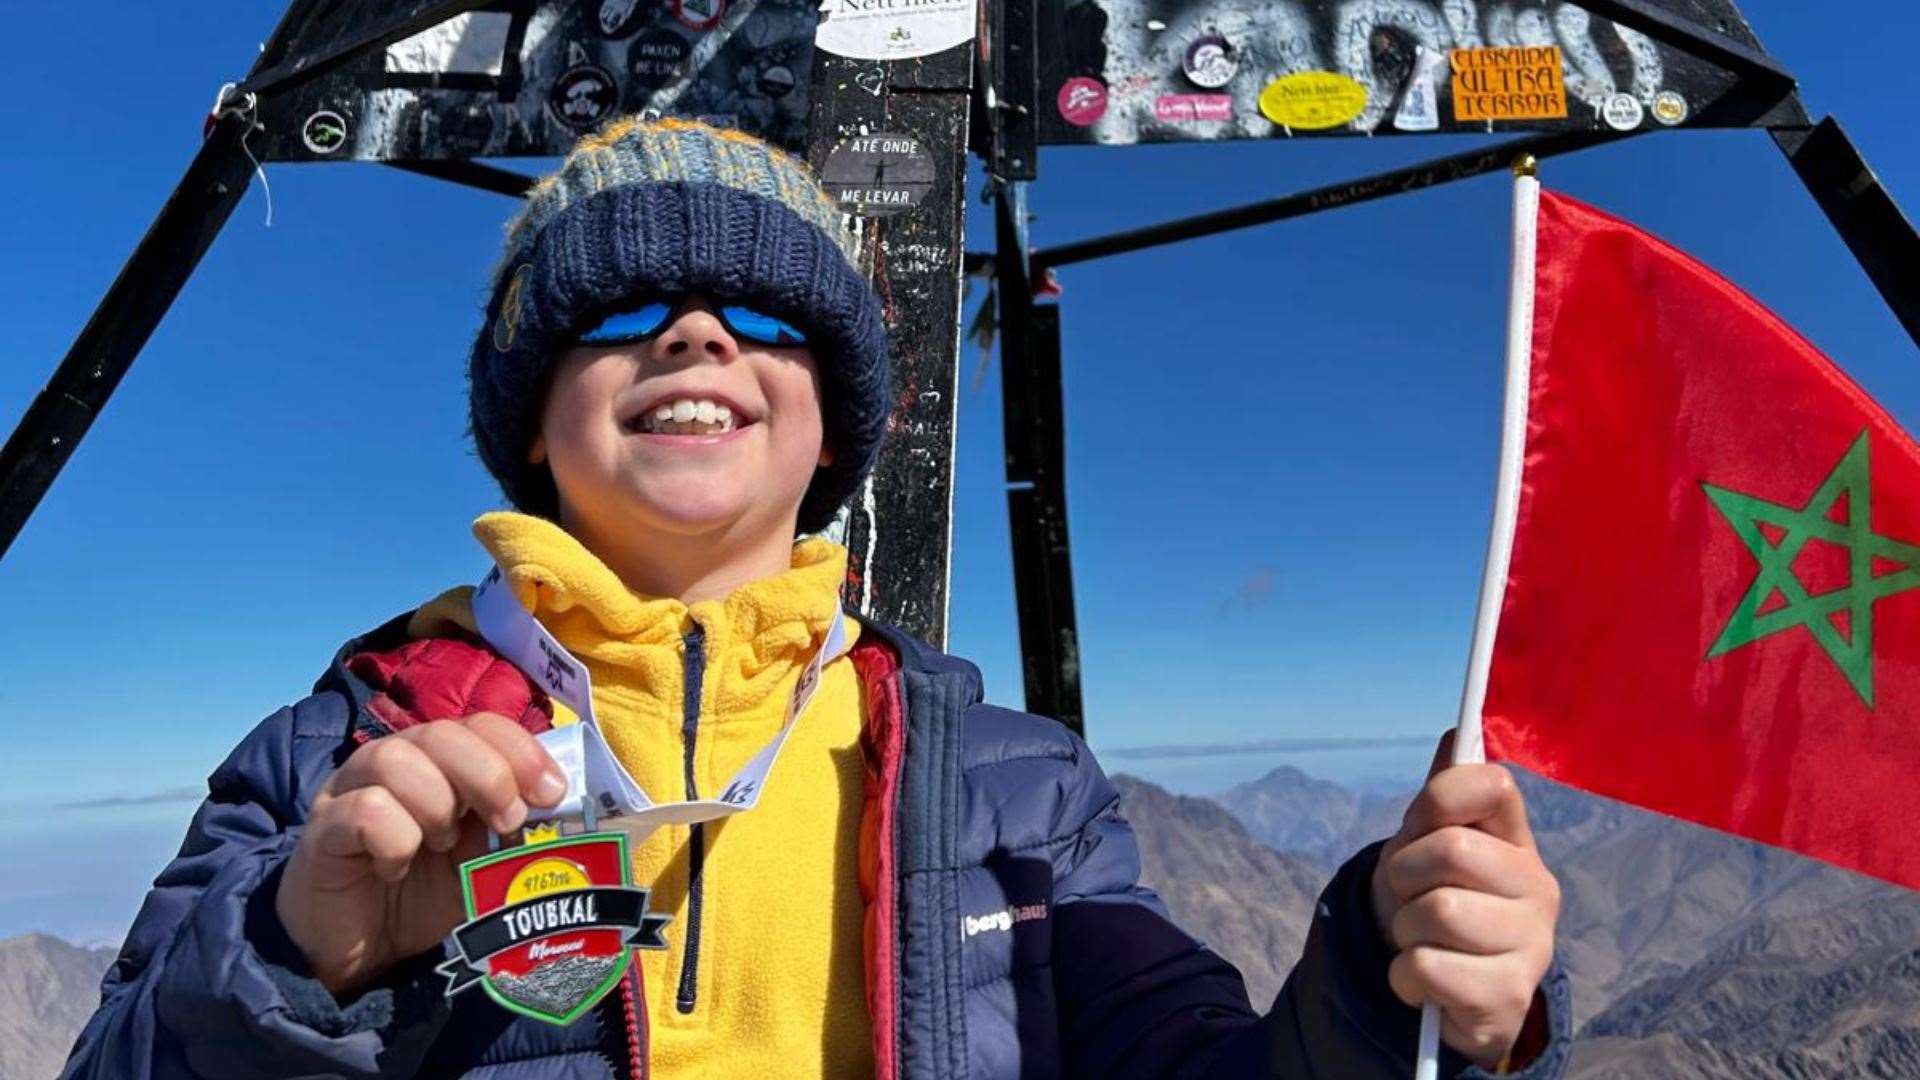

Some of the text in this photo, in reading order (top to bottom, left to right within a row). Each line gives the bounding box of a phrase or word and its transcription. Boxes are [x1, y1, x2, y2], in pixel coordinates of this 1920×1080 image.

[1460, 66, 1554, 93] ULTRA
[1460, 92, 1561, 116] TERROR
[882, 140, 918, 154] ONDE
[840, 189, 910, 204] ME LEVAR
[502, 893, 599, 940] TOUBKAL
